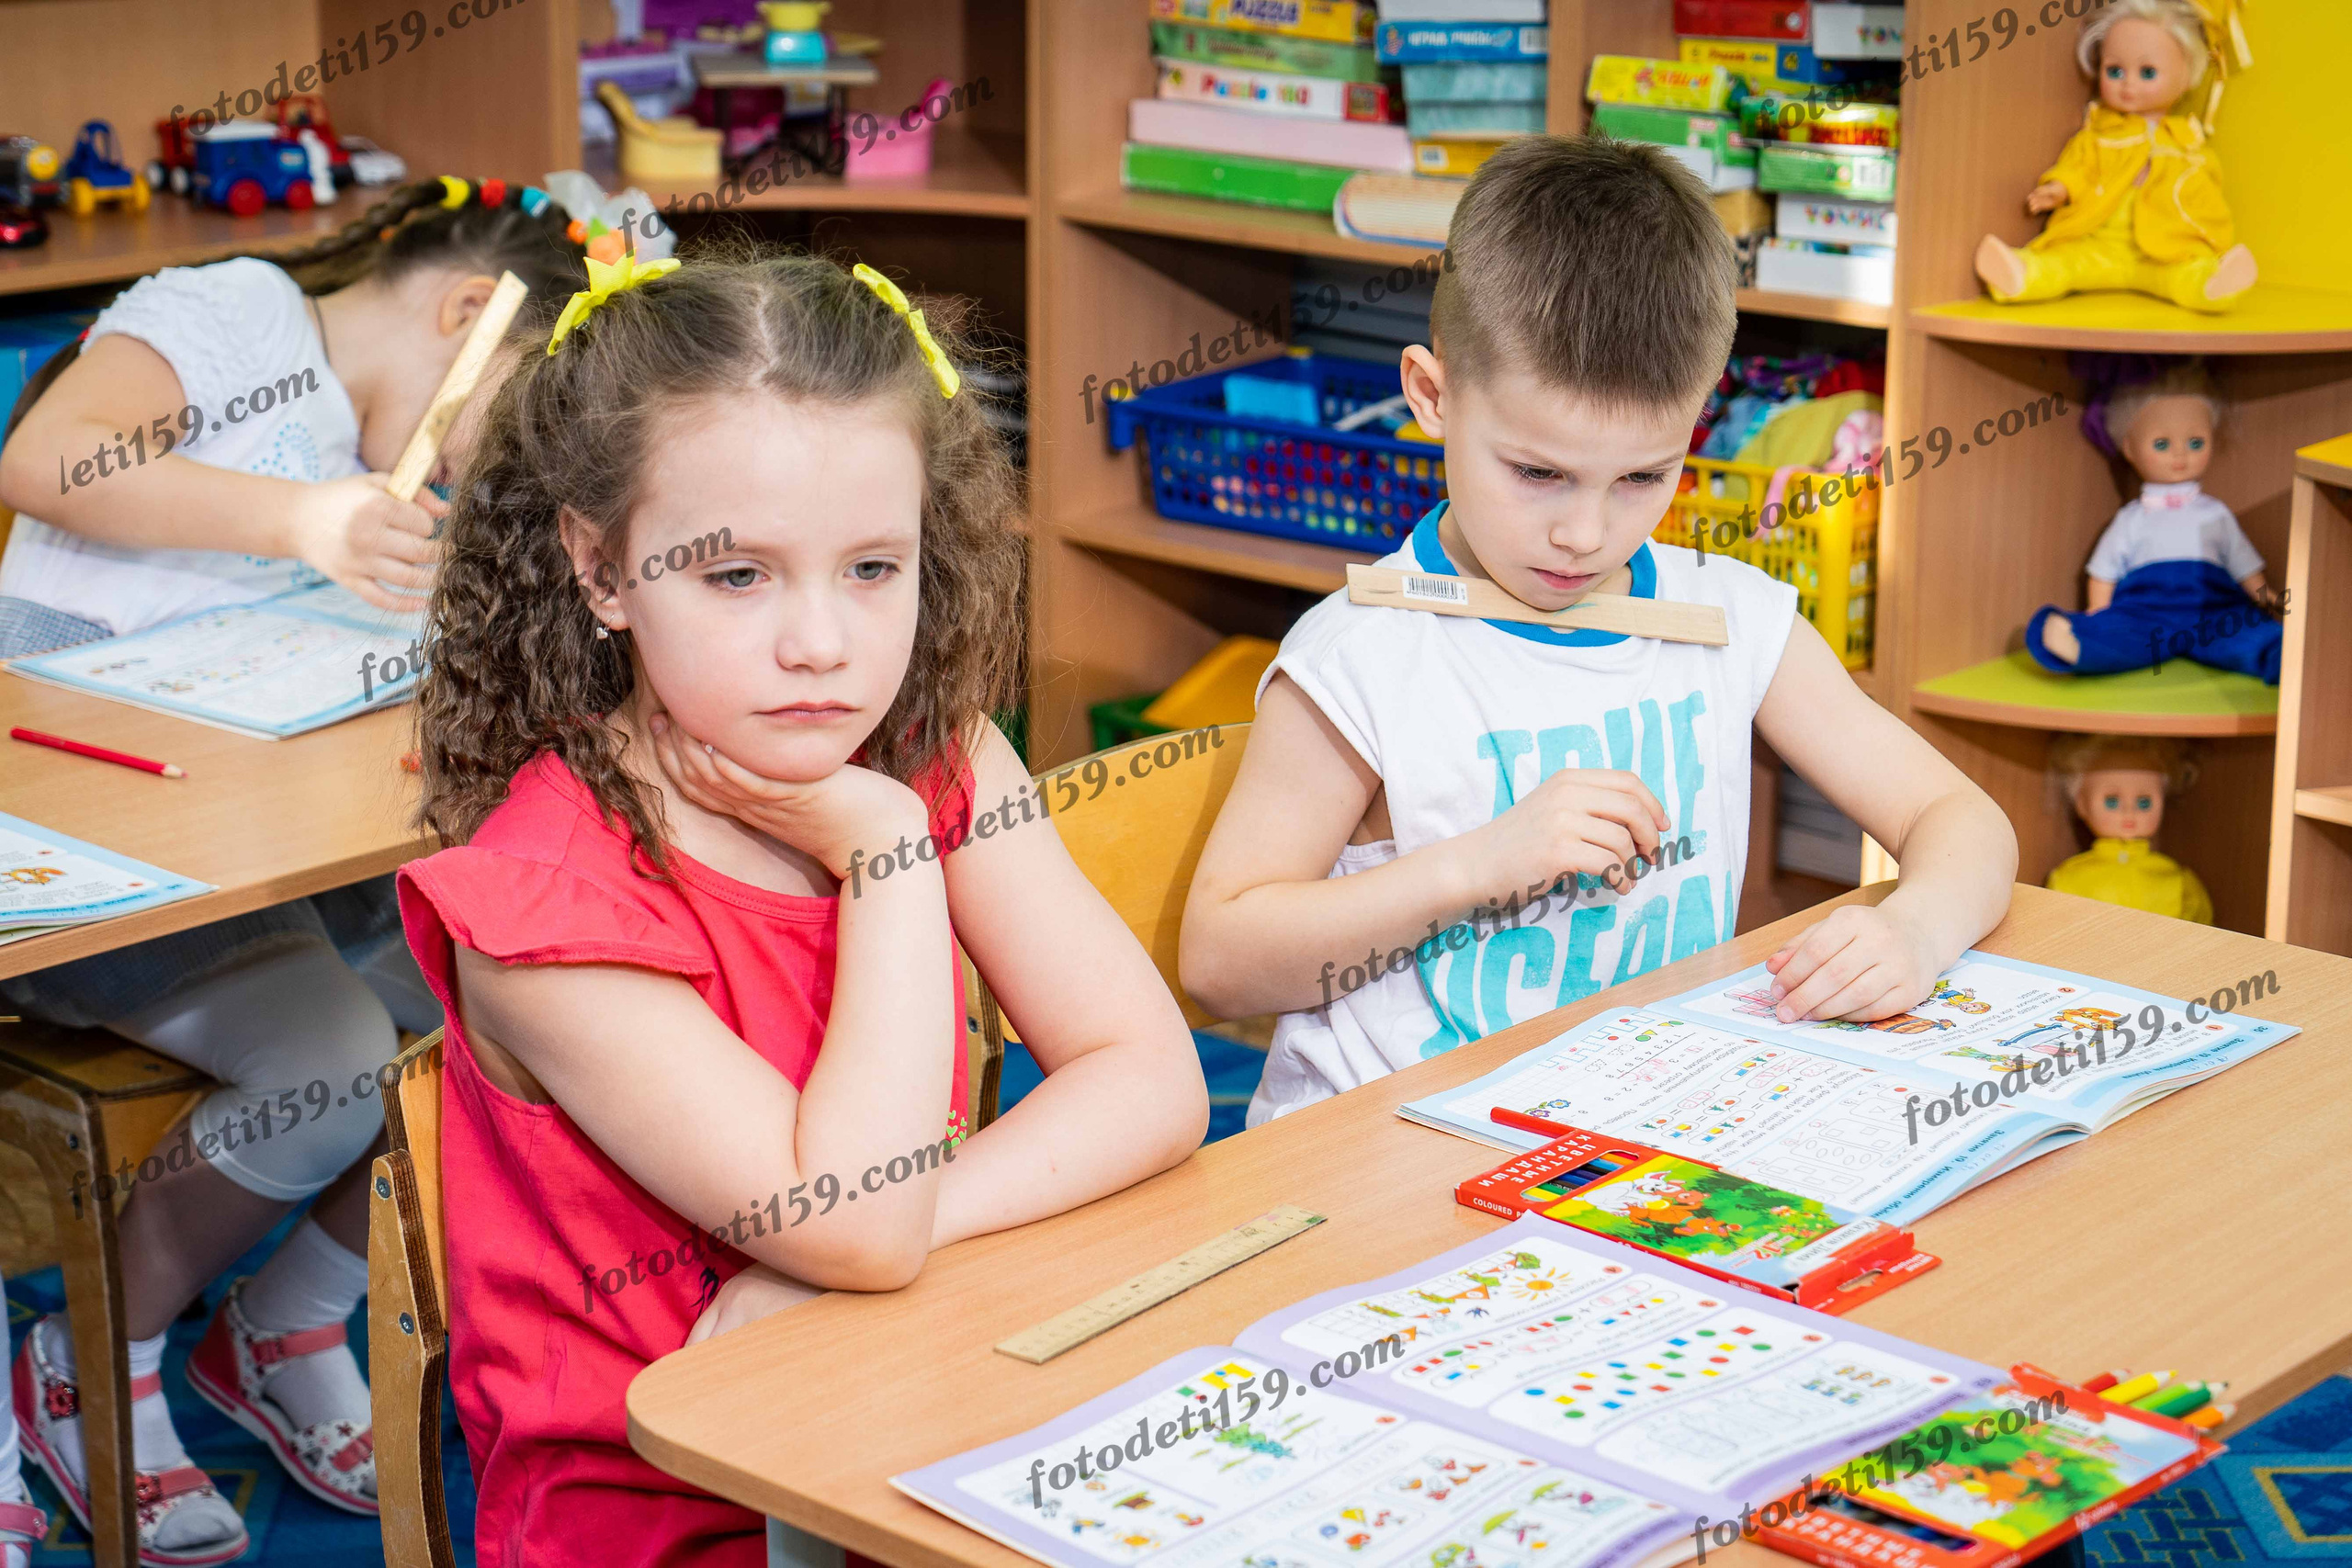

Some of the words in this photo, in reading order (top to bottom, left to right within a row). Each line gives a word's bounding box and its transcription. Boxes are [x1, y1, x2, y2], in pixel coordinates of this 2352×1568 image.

[1683, 1047, 1724, 1071] числовому
[1713, 1045, 1747, 1062] Подбери
[1663, 1062, 1713, 1093] пропущенные
[1801, 1089, 1830, 1108] фигуры
[1602, 1108, 1637, 1124] Проверь
[1968, 1130, 2005, 1152] Занятие
[1477, 1134, 1592, 1187] КАРАНДАШИ
[1510, 1142, 1597, 1184] ЦВЕТНЫЕ
[1902, 1167, 1953, 1200] Измерение
[1472, 1197, 1513, 1217] COLOURED
[1871, 1201, 1902, 1219] объём
